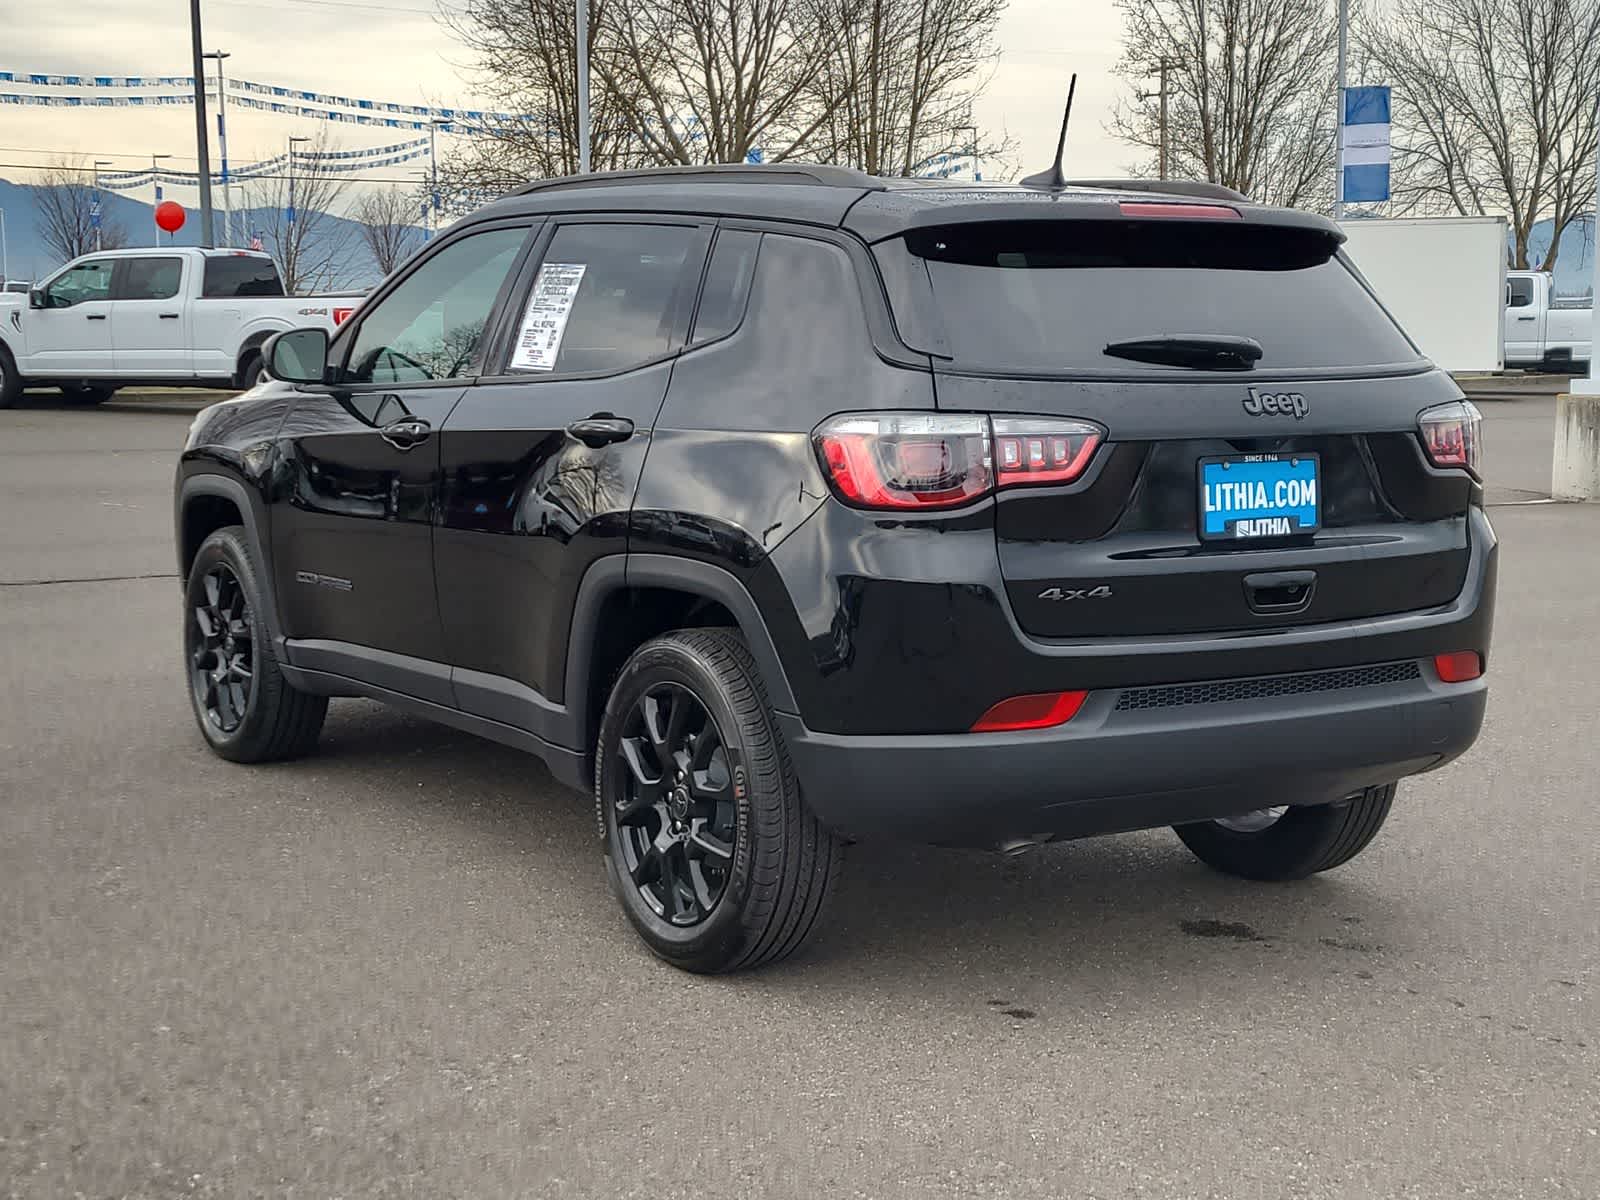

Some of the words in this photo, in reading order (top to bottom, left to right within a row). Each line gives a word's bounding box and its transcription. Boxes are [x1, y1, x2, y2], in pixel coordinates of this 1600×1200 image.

[1242, 387, 1310, 420] Jeep
[1244, 455, 1263, 463] SINCE
[1205, 479, 1316, 513] LITHIA.COM
[1249, 517, 1291, 537] LITHIA
